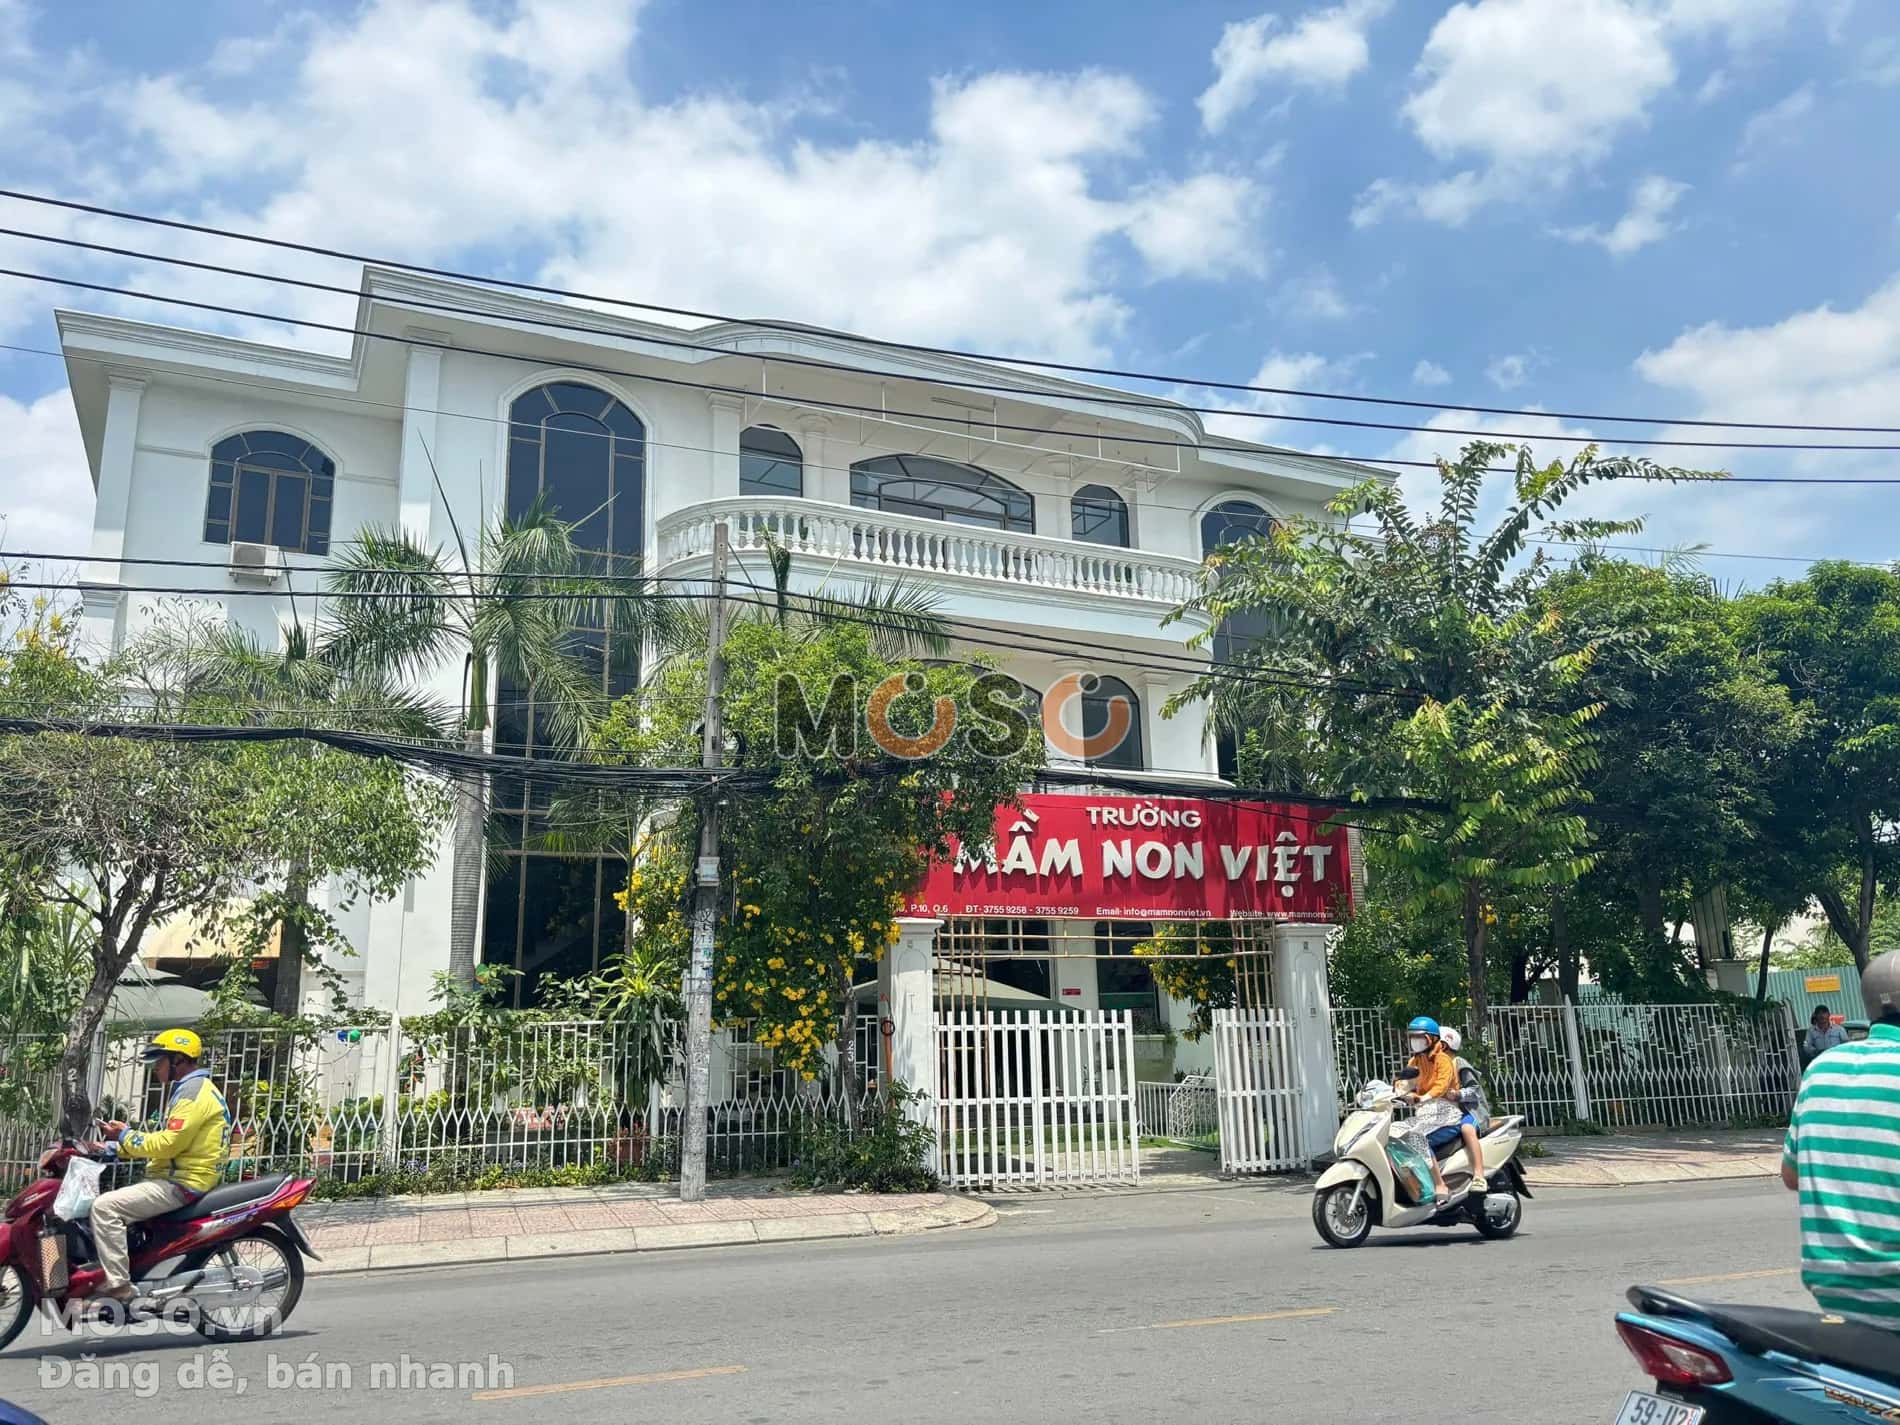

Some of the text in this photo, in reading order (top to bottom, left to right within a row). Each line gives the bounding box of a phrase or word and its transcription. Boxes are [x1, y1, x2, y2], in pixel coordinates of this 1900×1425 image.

[1086, 801, 1202, 828] TRƯỜNG
[953, 808, 1333, 898] MẦM NON VIỆT
[983, 905, 1005, 914] 3755
[1035, 906, 1057, 915] 3755
[1058, 906, 1079, 915] 9259
[1123, 907, 1212, 917] info@mamnonviet.vn
